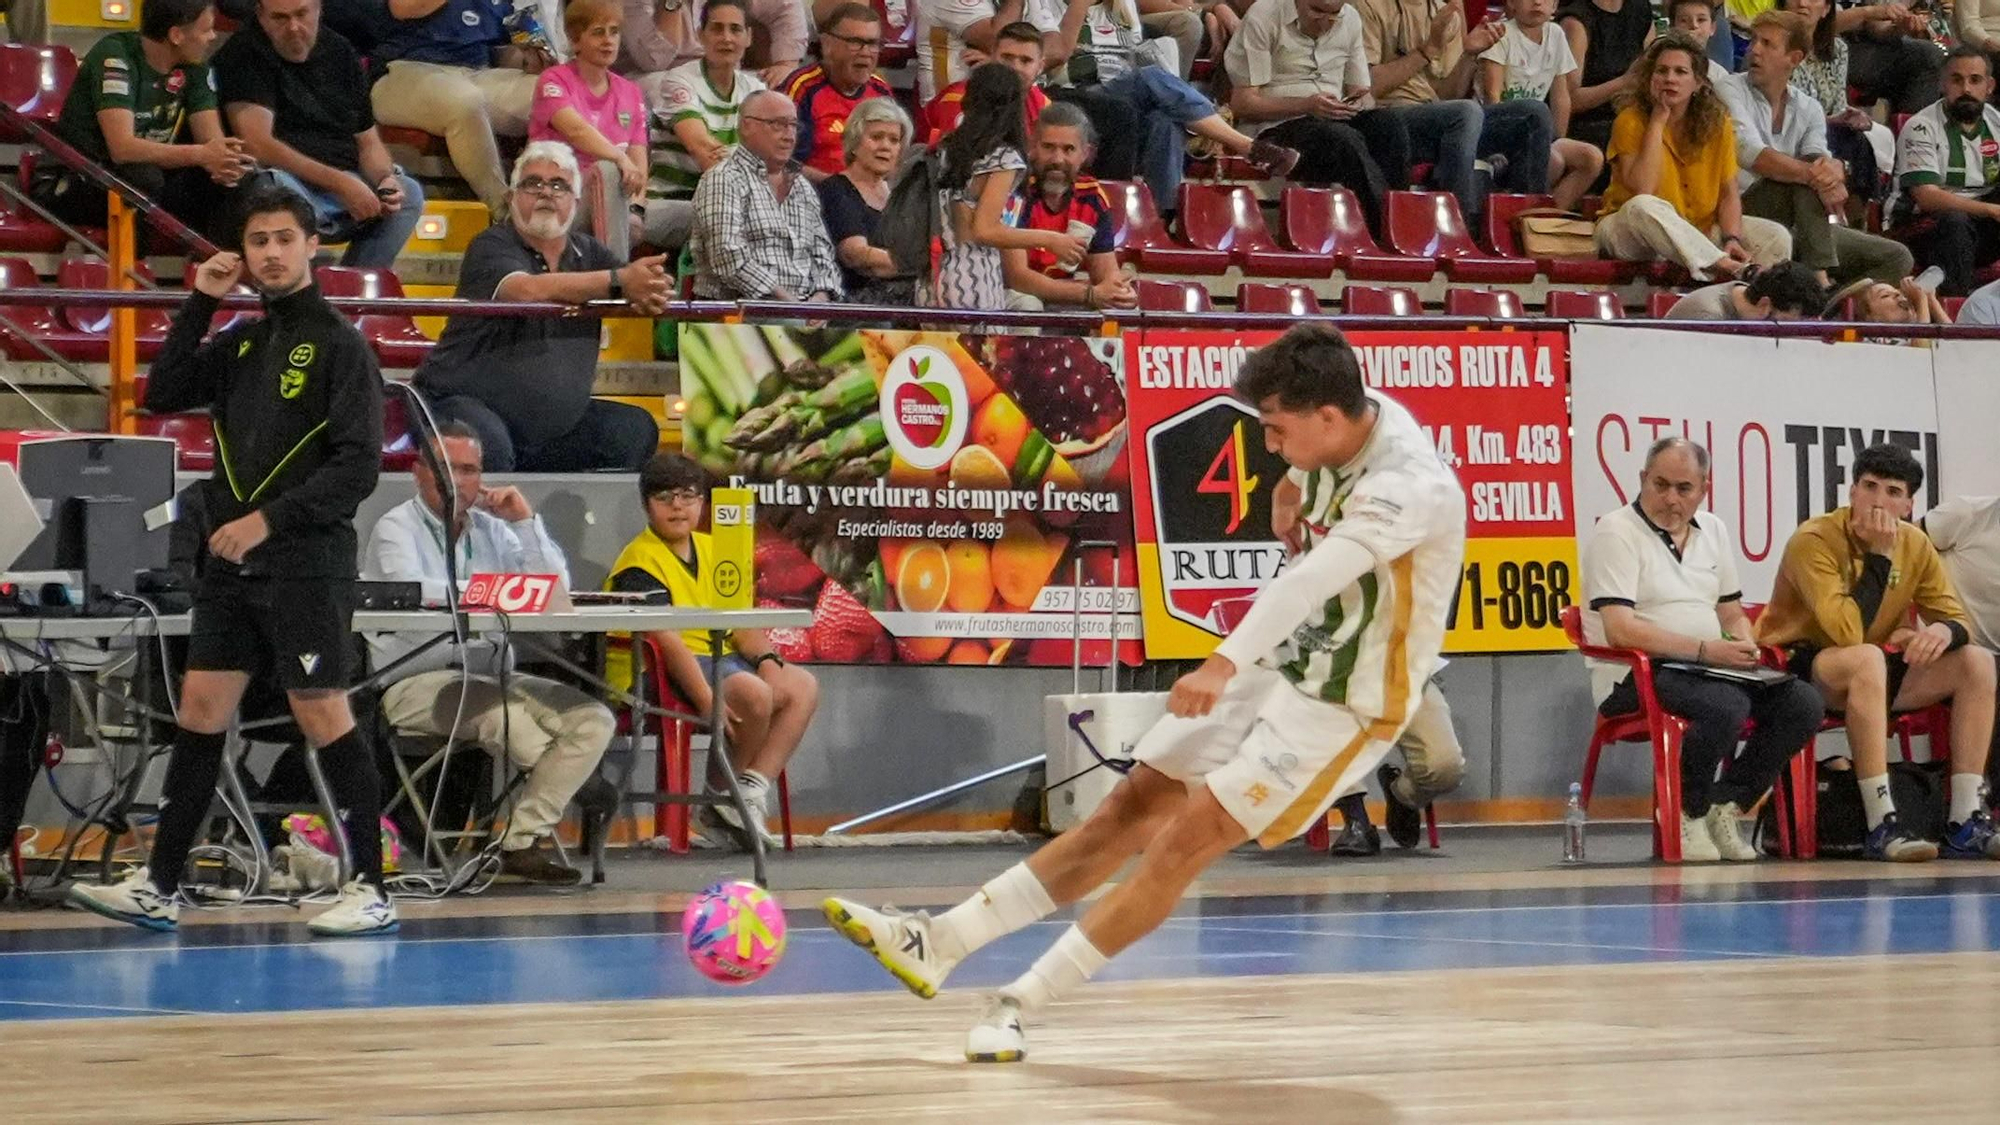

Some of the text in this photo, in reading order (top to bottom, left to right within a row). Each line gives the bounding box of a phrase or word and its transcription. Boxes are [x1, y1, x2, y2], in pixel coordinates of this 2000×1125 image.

[1138, 339, 1257, 389] ESTACIÓ
[1459, 346, 1529, 388] RUTA
[1534, 346, 1554, 388] 4
[901, 404, 950, 415] HERMANOS
[901, 414, 935, 425] CASTRO
[1466, 425, 1511, 464] Km.
[1516, 424, 1562, 464] 483
[805, 484, 823, 514] y
[827, 477, 930, 508] verdura
[935, 480, 1037, 518] siempre
[1042, 480, 1120, 513] fresca
[1472, 482, 1564, 521] SEVILLA
[717, 508, 737, 520] SV
[837, 519, 1004, 540] Especialistas desde 1989
[1044, 591, 1069, 608] 957
[1117, 591, 1135, 609] 97
[935, 616, 1135, 635] www.frutashermanoscstro.om
